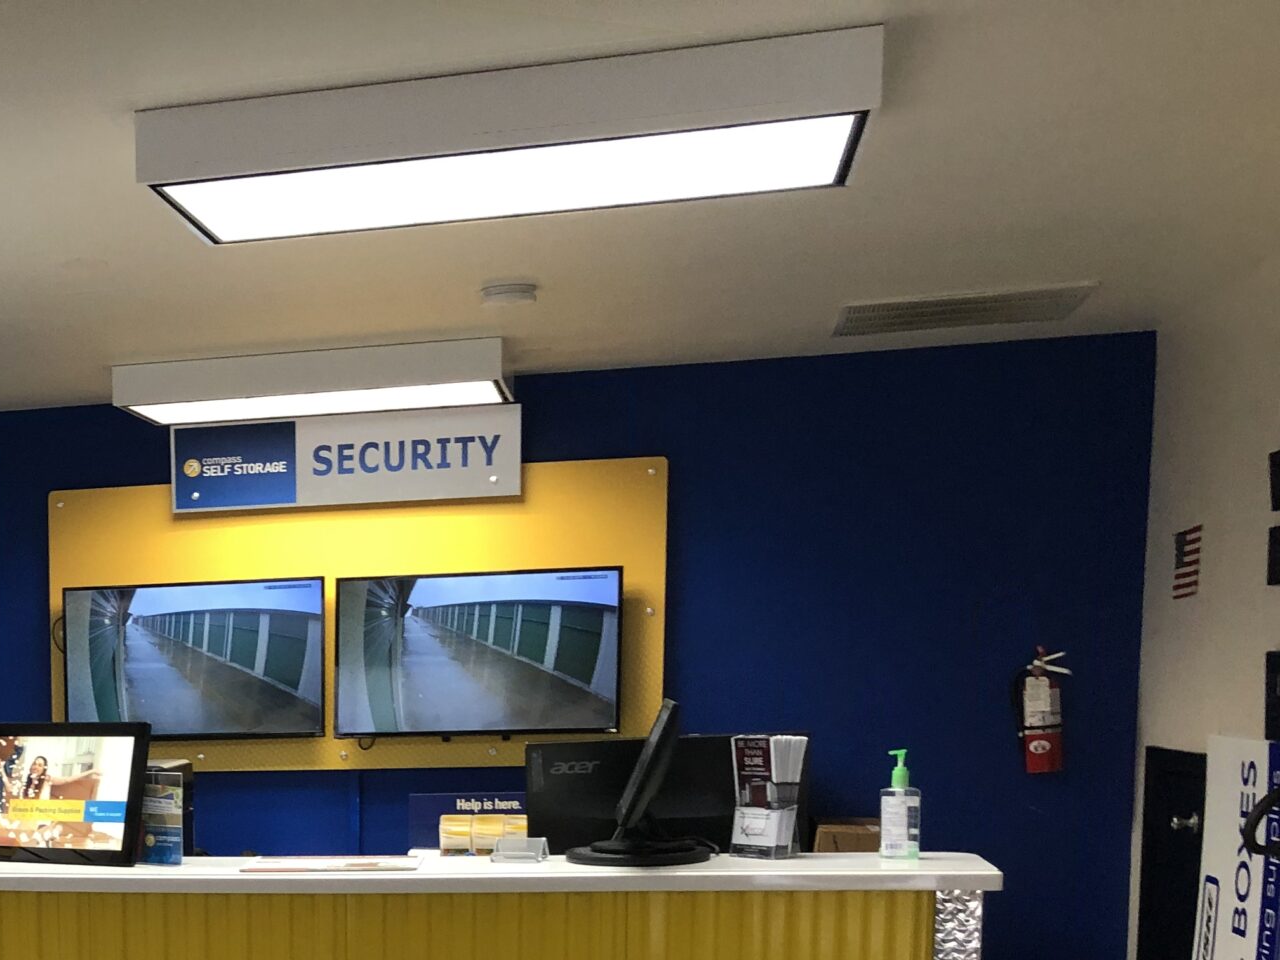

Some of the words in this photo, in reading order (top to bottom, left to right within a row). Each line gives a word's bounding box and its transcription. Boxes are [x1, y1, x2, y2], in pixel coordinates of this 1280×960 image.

[201, 456, 243, 466] compass
[311, 434, 501, 477] SECURITY
[202, 465, 232, 477] SELF
[233, 461, 287, 475] STORAGE
[549, 760, 601, 774] acer
[743, 757, 764, 766] SURE
[456, 798, 482, 812] Help
[483, 798, 493, 810] is
[494, 798, 523, 810] here.
[1231, 760, 1259, 939] BOXES
